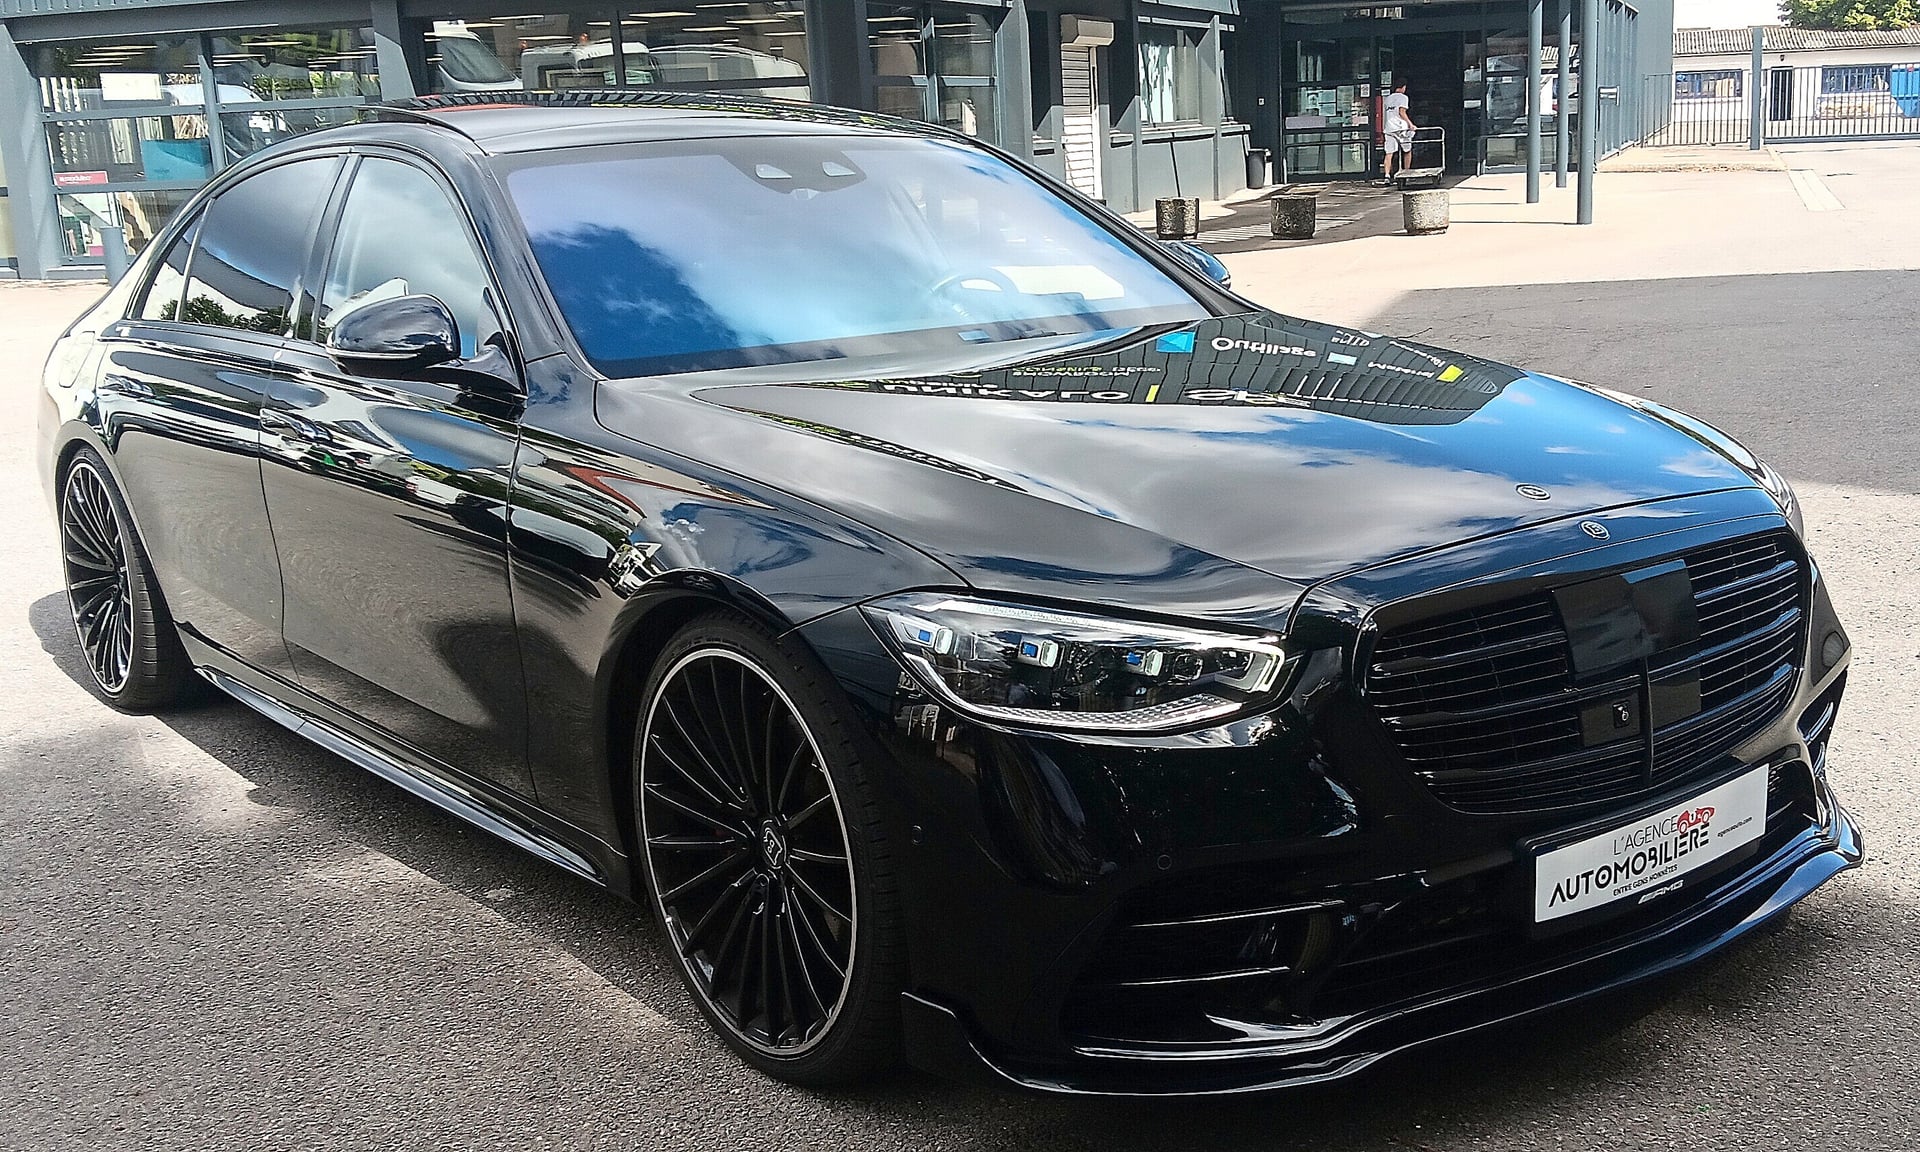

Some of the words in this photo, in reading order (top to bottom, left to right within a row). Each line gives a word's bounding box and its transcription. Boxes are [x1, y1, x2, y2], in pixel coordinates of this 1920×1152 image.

[1613, 814, 1679, 856] L'AGENCE
[1613, 882, 1633, 897] ENTRE
[1632, 876, 1649, 889] GENS
